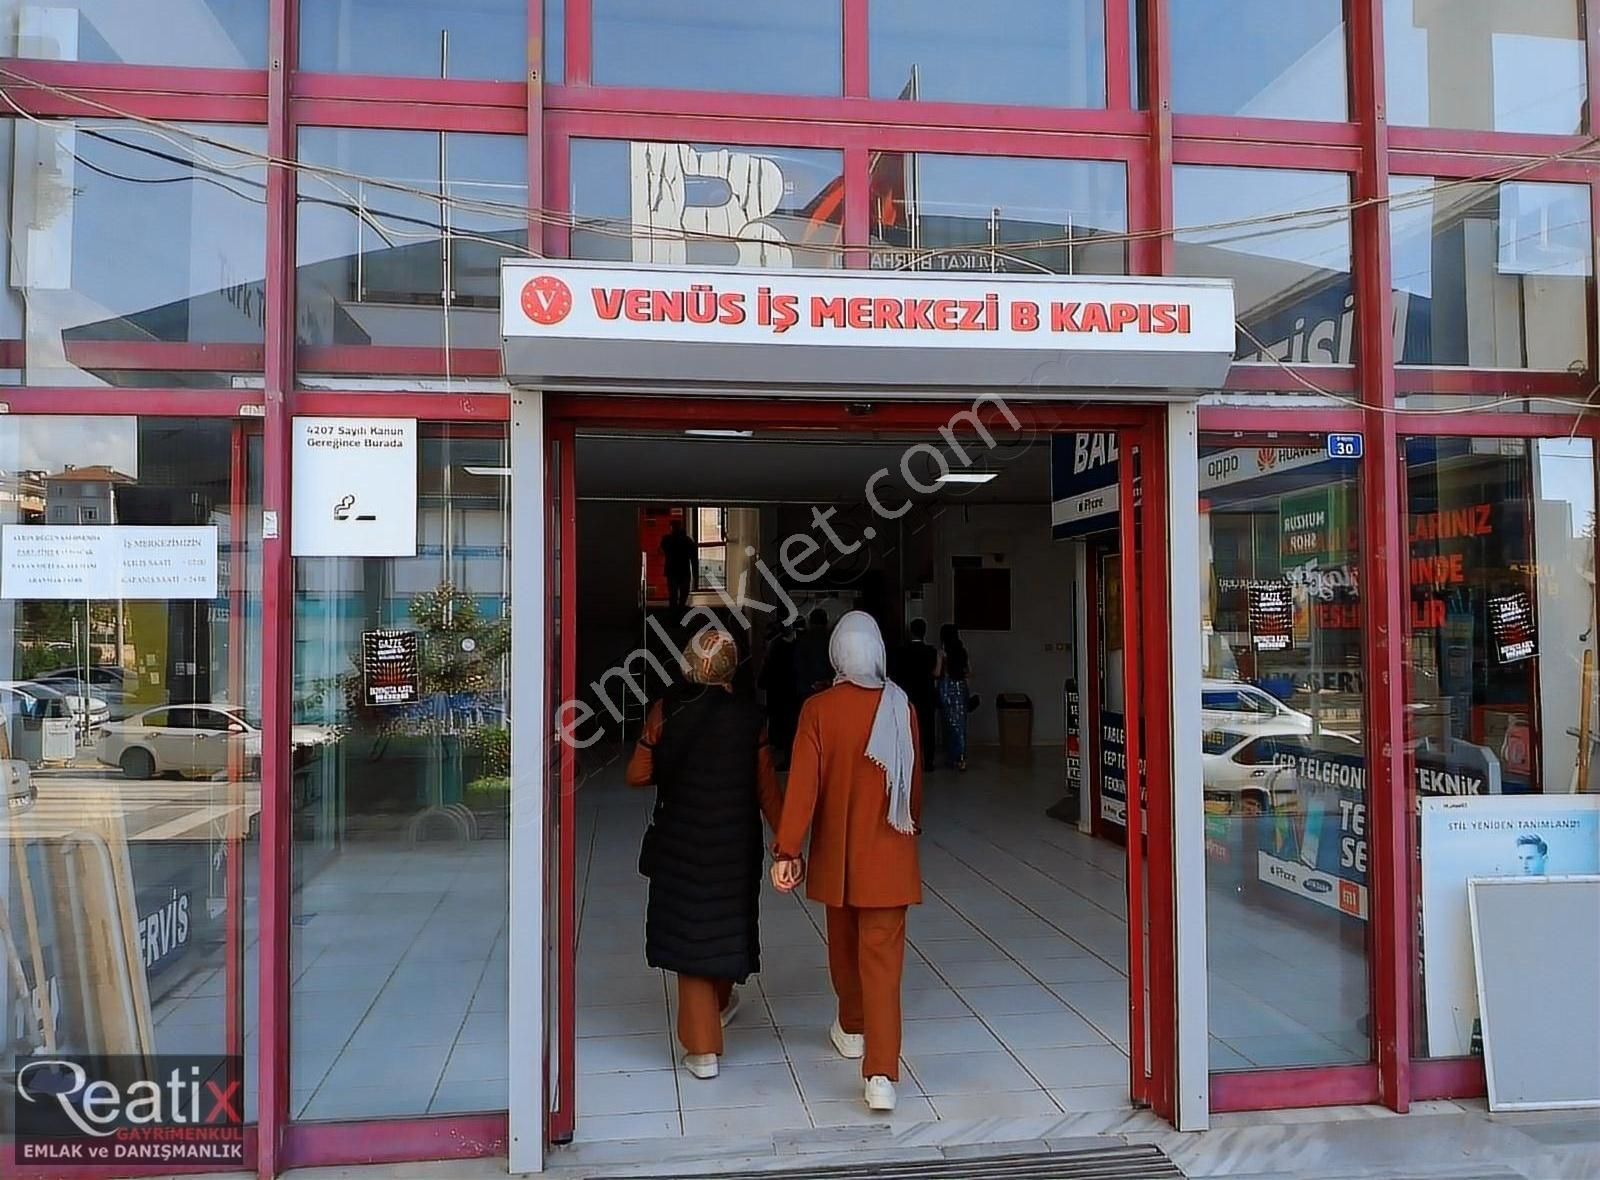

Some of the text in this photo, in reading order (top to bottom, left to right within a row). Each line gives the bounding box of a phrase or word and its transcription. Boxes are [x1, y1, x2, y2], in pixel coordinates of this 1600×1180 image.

[592, 285, 1191, 333] VENÜS İŞ MERKEZİ B KAPISI
[307, 426, 403, 437] 4207 Sayılı Kanun
[364, 438, 403, 448] Burada
[1337, 442, 1353, 455] 30
[1208, 455, 1239, 480] oppo
